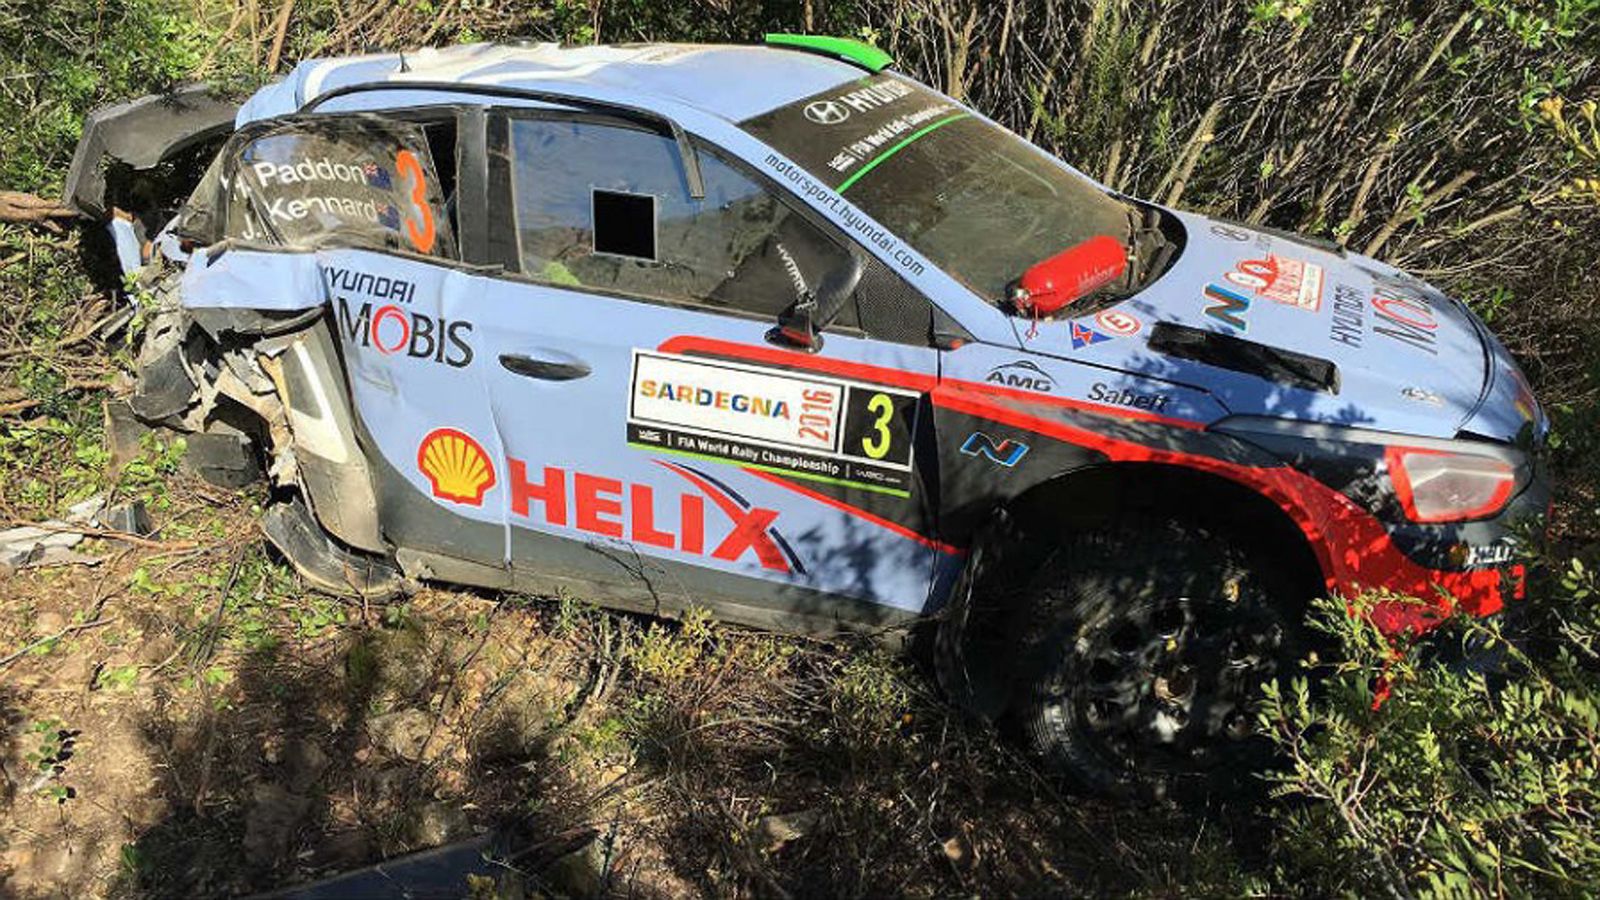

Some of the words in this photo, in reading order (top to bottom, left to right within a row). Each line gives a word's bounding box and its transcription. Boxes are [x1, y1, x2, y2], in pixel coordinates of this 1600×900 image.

[254, 158, 367, 189] Paddon
[242, 213, 261, 240] J.
[266, 198, 378, 225] Kennard
[396, 149, 436, 252] 3
[763, 152, 926, 277] motorsport.hyundai.com
[324, 266, 416, 303] YUNDAI
[337, 297, 474, 368] MOBIS
[986, 371, 1051, 392] AMG
[1088, 382, 1169, 413] Sabelt
[640, 379, 790, 420] SARDEGNA
[798, 388, 835, 443] 2016
[862, 393, 893, 459] 3
[676, 437, 697, 450] FIA
[699, 439, 729, 455] World
[731, 445, 759, 462] Rally
[761, 450, 840, 475] Championship
[507, 457, 792, 574] HELIX
